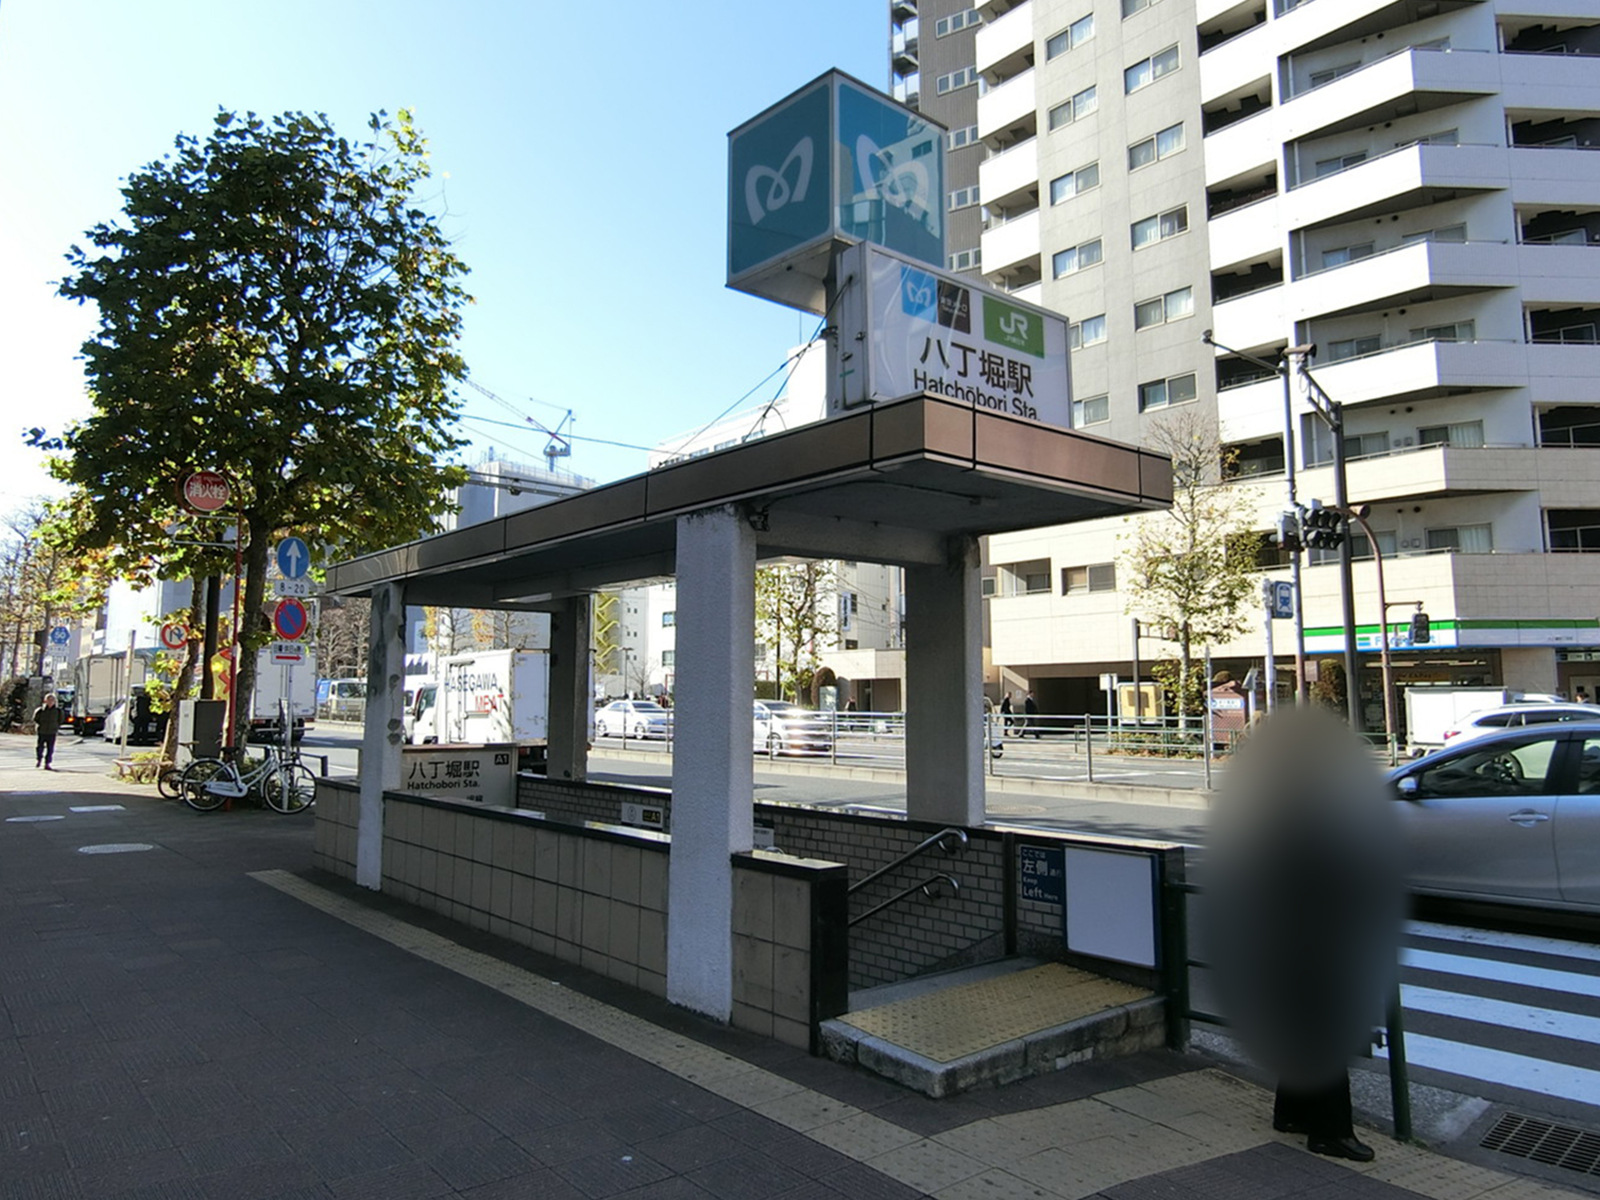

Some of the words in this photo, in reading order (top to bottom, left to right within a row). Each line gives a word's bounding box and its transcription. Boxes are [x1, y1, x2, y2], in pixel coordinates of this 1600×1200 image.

[1000, 312, 1028, 339] JR
[920, 336, 1034, 398] 八丁堀駅
[189, 481, 226, 500] 消火栓
[445, 673, 498, 692] HASEGAWA
[475, 694, 504, 713] MEAT
[495, 754, 508, 766] A1
[409, 761, 480, 779] 八丁堀駅
[1022, 849, 1046, 859] ここでは
[1023, 859, 1048, 876] 左側
[1023, 886, 1043, 898] Left
